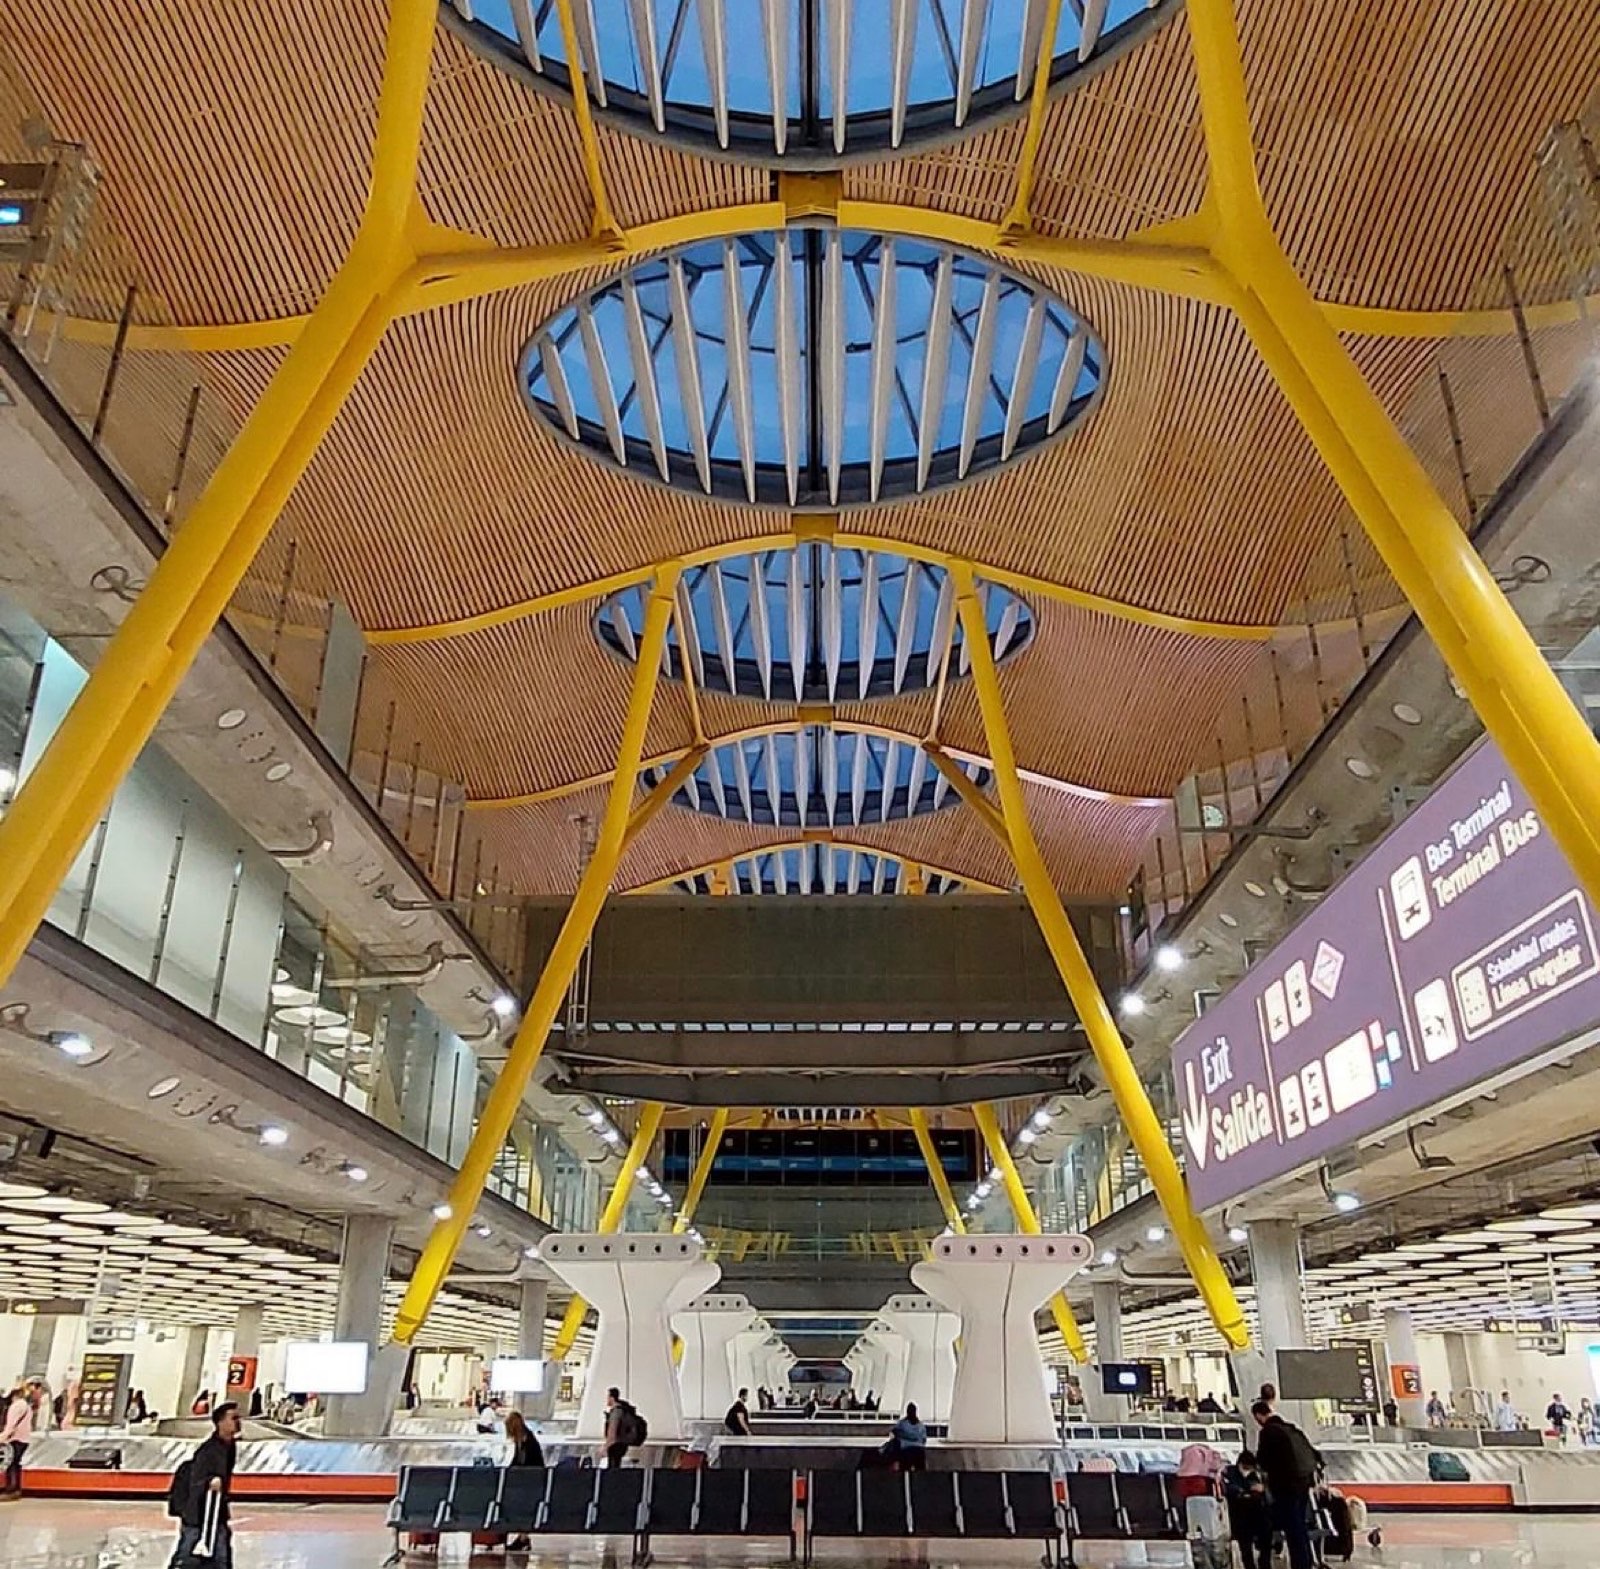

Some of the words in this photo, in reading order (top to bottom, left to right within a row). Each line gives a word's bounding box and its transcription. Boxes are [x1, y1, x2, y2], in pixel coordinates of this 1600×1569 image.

[1425, 839, 1453, 873] Bus
[1449, 780, 1512, 849] Terminal
[1432, 832, 1500, 907] Terminal
[1499, 810, 1540, 857] Bus
[1487, 936, 1540, 984] Scheduled
[1539, 918, 1577, 953] routes
[1529, 944, 1582, 990] regular
[1201, 1037, 1233, 1094] Exit
[1212, 1084, 1274, 1161] Salida
[230, 1372, 242, 1385] 2
[1407, 1381, 1419, 1392] 2
